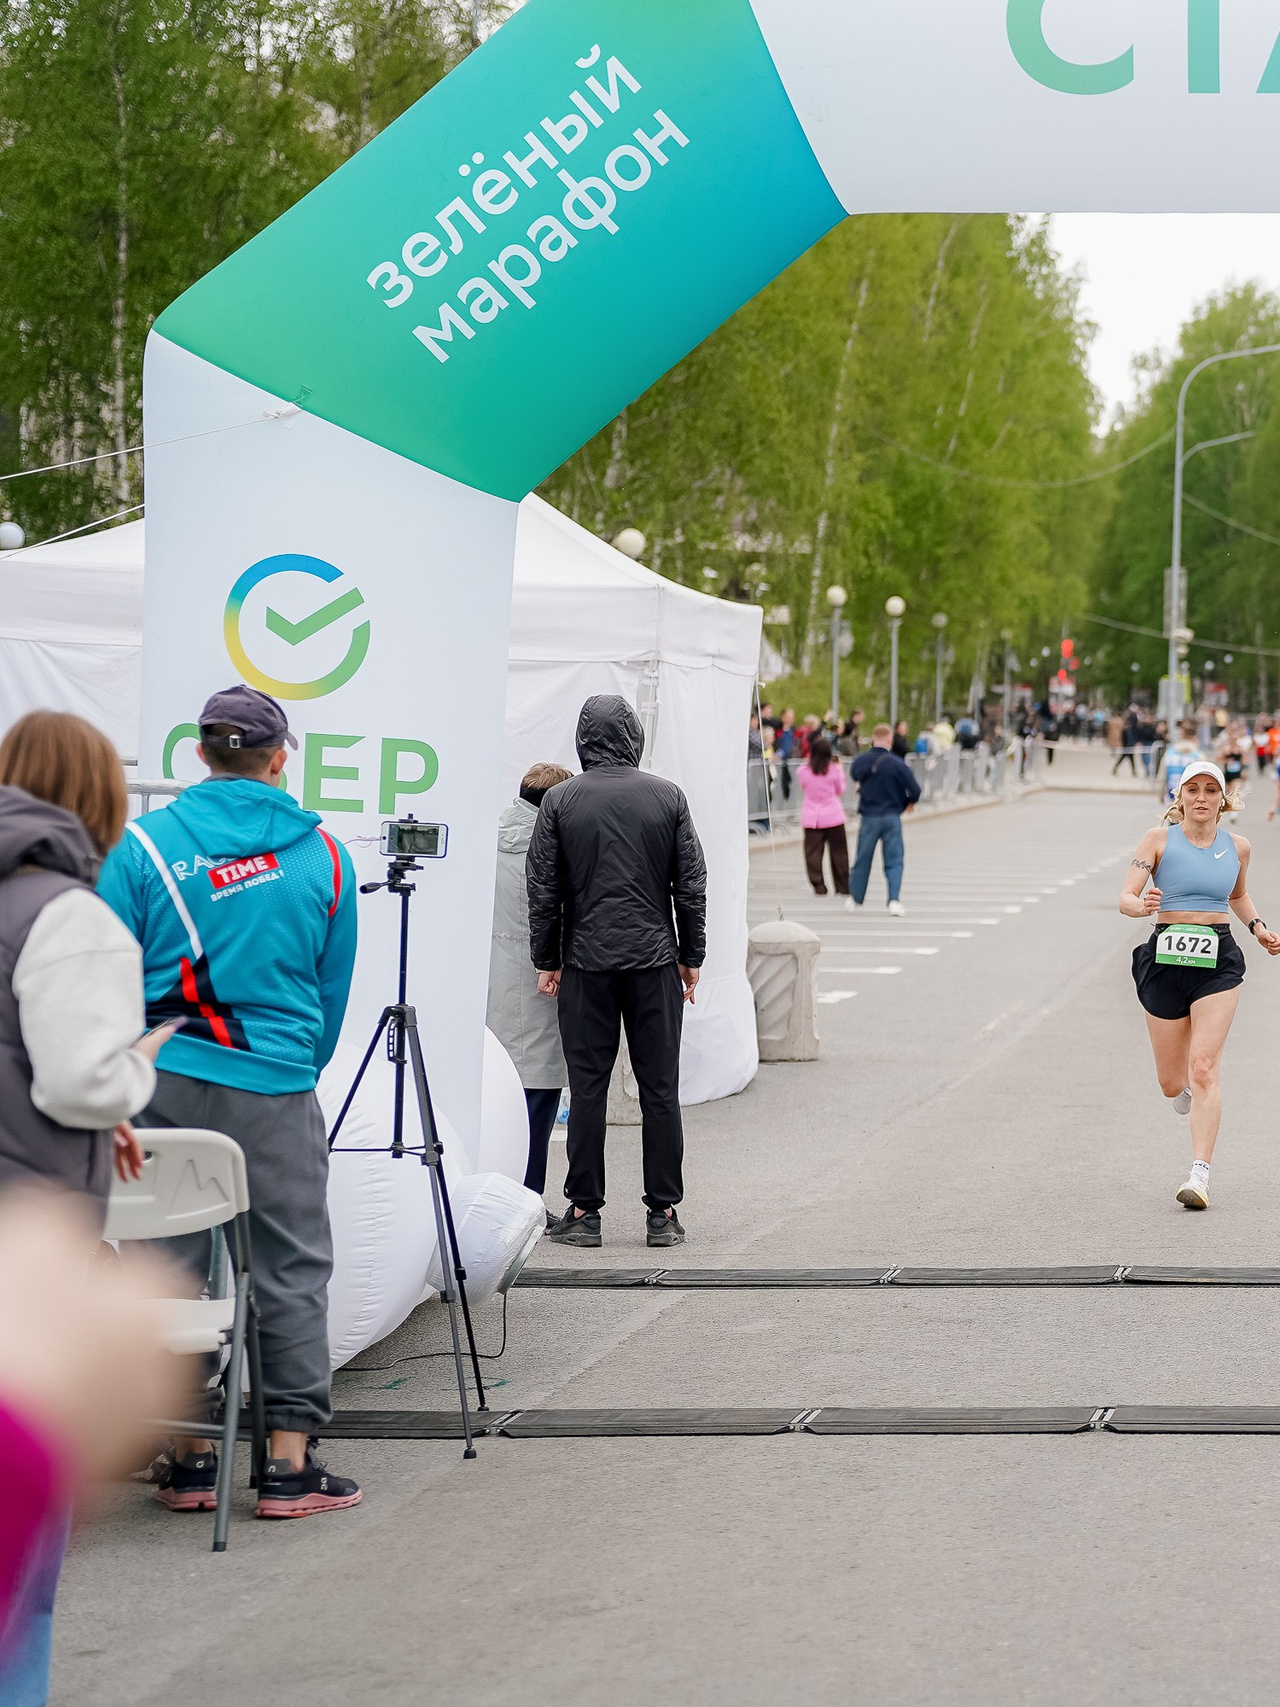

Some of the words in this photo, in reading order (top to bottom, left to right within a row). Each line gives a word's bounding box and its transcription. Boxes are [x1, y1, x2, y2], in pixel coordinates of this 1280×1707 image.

[367, 44, 642, 308] зелёный
[412, 109, 690, 364] марафон
[162, 723, 440, 815] ЕР
[172, 854, 238, 881] RAC
[216, 856, 269, 884] TIME
[210, 884, 244, 902] ВРЕМЯ
[1165, 935, 1212, 954] 1672
